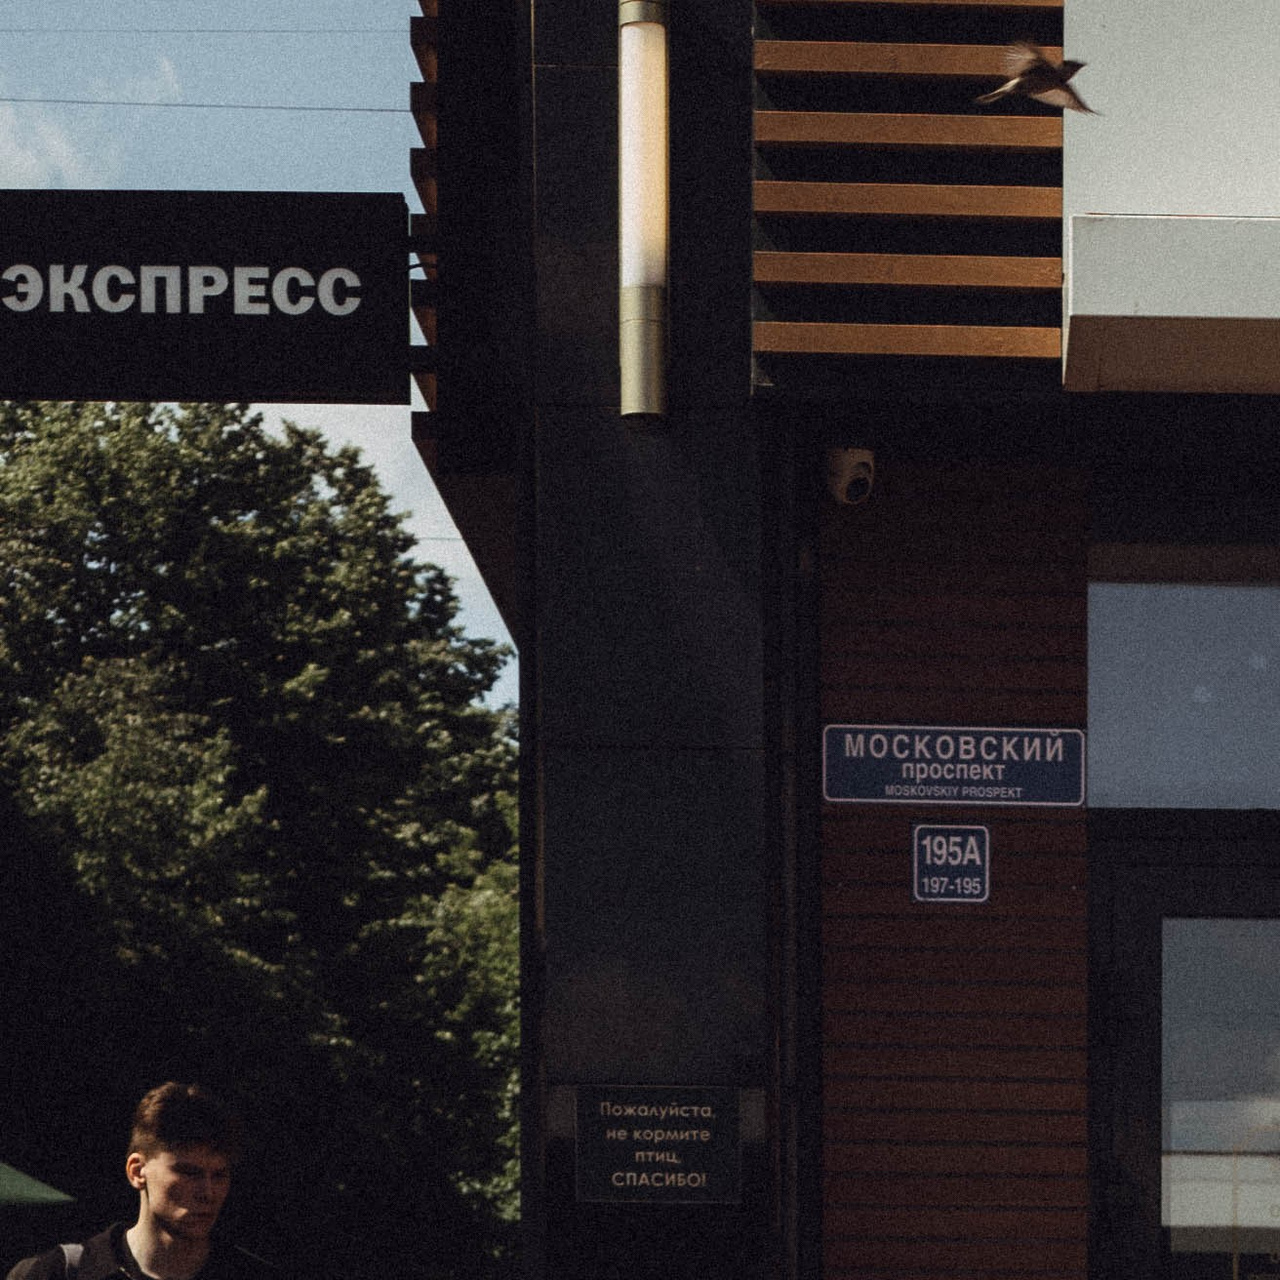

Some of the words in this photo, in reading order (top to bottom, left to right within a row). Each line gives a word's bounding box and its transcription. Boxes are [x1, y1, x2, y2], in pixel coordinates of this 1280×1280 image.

[1, 264, 362, 316] ЭКСПРЕСС
[844, 729, 1064, 762] МОСКОВСКИЙ
[901, 762, 1006, 783] проспект
[884, 784, 959, 798] MOSKOVSKIY
[962, 786, 1023, 799] PROSPEKT
[921, 835, 982, 866] 195А
[922, 876, 982, 895] 197-195
[606, 1129, 628, 1141] не
[633, 1129, 711, 1144] кормите
[611, 1172, 708, 1188] СПАСИБО!
